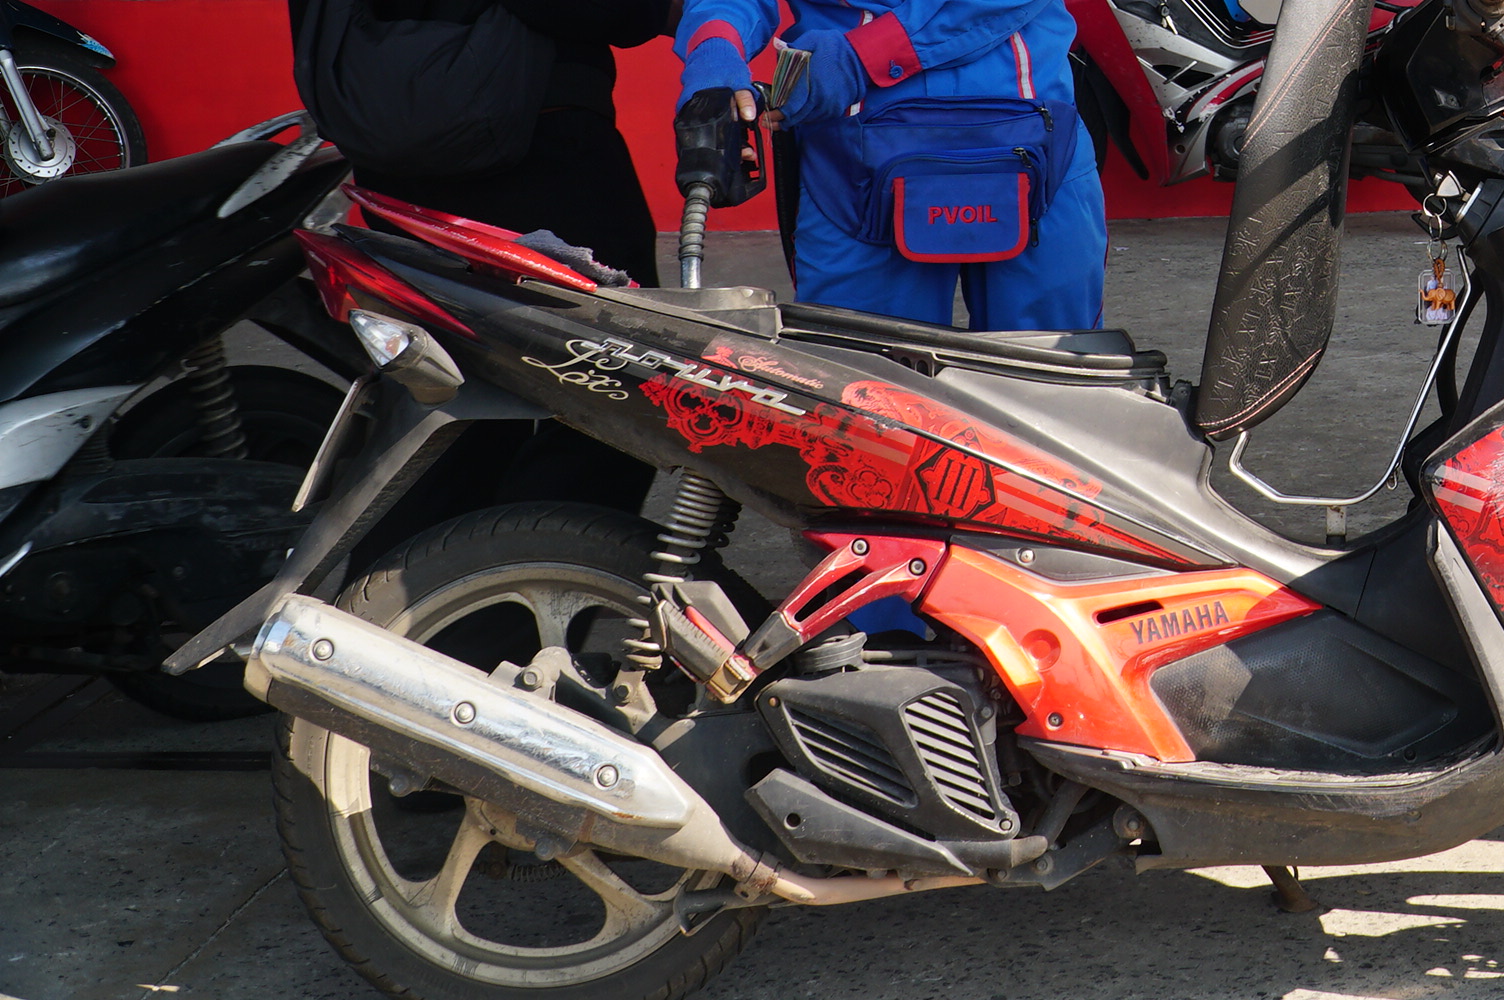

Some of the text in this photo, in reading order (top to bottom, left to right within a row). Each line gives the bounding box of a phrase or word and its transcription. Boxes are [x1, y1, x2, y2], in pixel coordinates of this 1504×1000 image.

[928, 205, 998, 225] PVOIL
[738, 354, 825, 390] Automatic
[1129, 601, 1230, 645] YAMAHA
